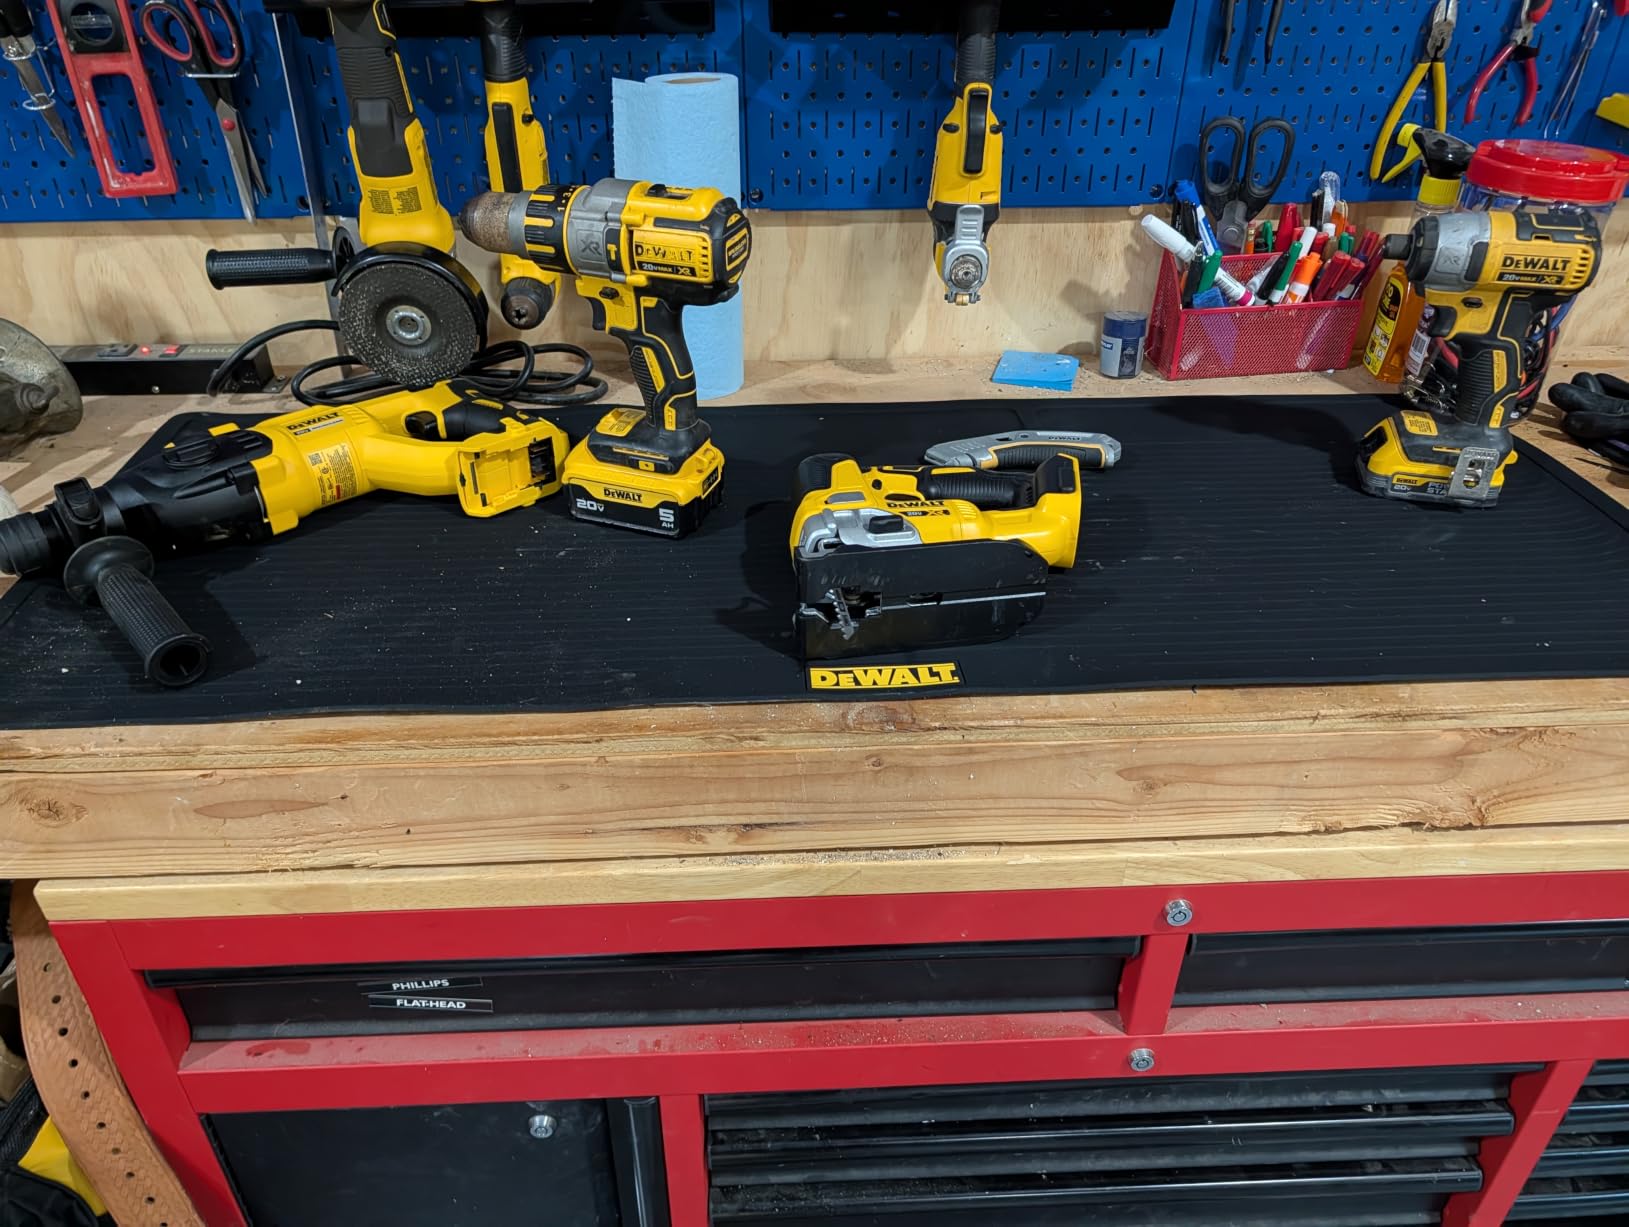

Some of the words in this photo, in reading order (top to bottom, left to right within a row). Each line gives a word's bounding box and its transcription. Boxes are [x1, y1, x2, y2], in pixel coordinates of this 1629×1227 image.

[1501, 256, 1570, 271] DEWALT
[603, 488, 642, 502] DEWALT
[659, 508, 675, 523] 5
[391, 979, 450, 991] PHILLIPS
[396, 998, 467, 1009] FLAT-HEAD
